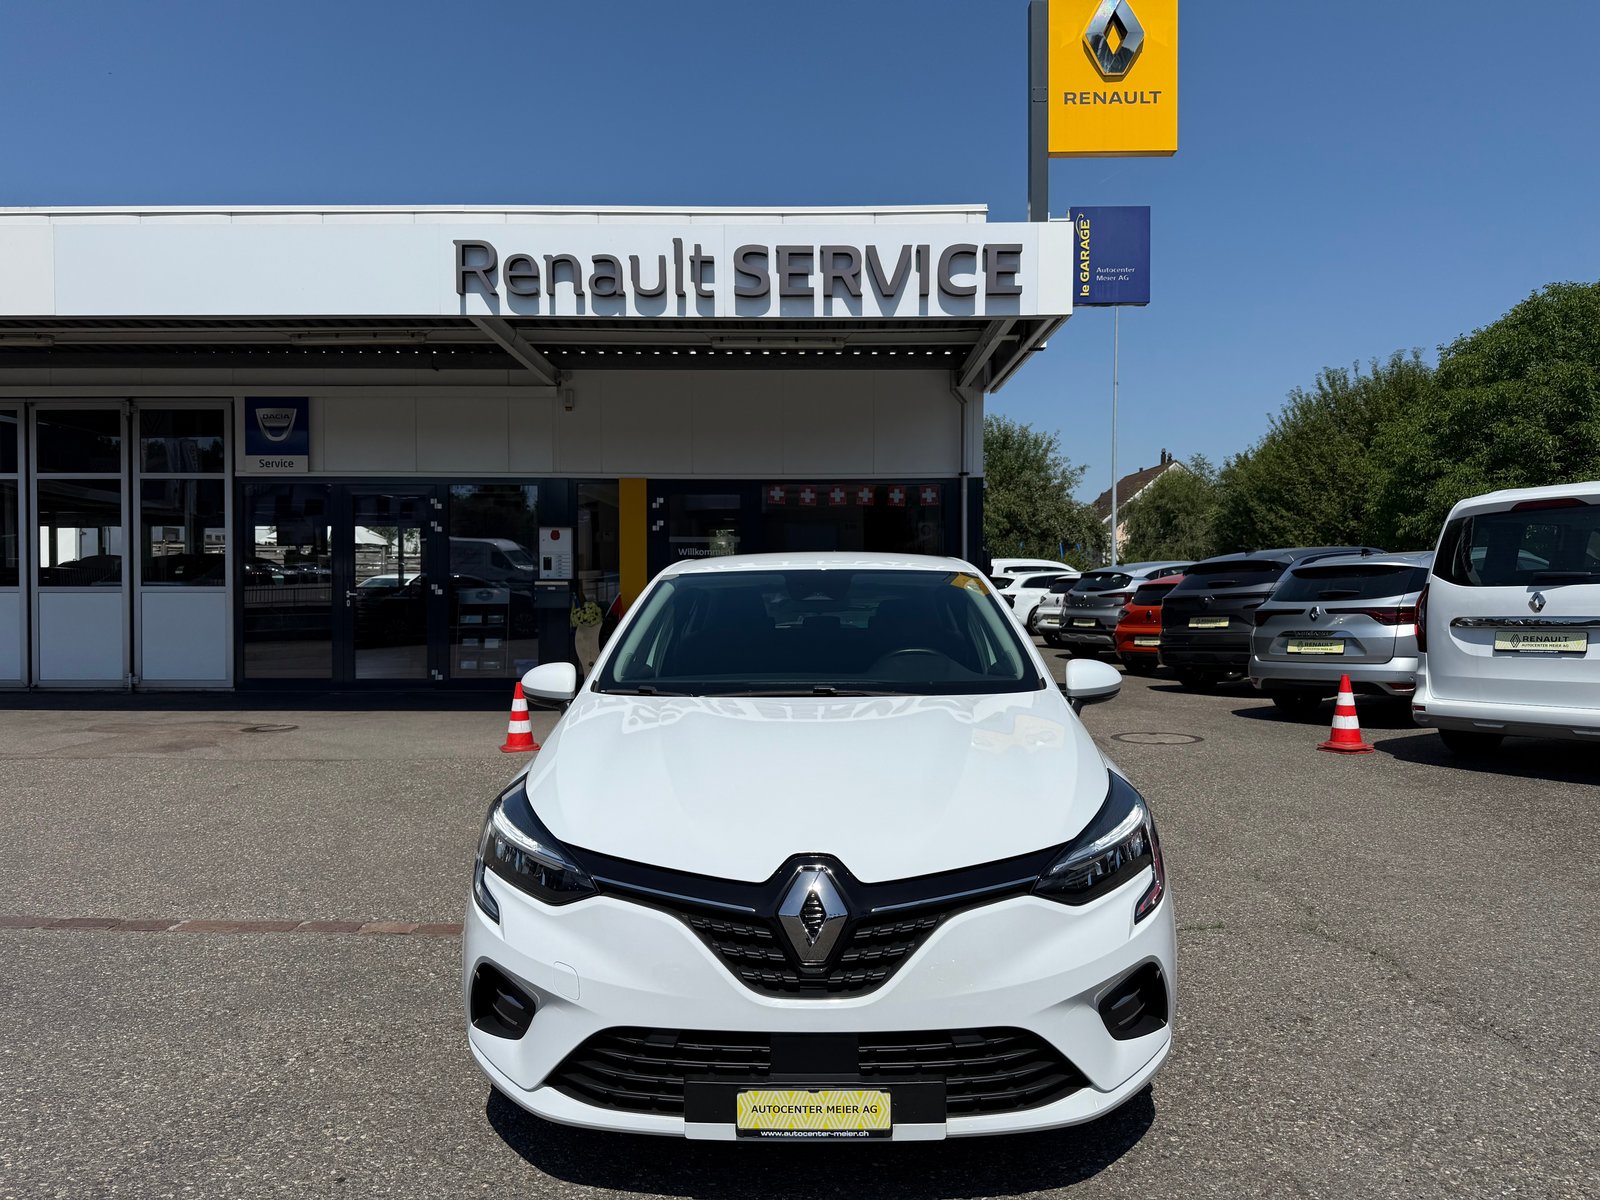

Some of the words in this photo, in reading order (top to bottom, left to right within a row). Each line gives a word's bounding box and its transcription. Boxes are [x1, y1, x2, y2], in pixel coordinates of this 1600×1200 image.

[1064, 91, 1162, 105] RENAULT
[1079, 219, 1090, 283] GARAGE
[452, 237, 715, 297] Renault
[733, 243, 1023, 297] SERVICE
[1080, 284, 1090, 297] le
[258, 458, 294, 468] Service
[1522, 635, 1570, 643] RENAULT
[751, 1105, 823, 1114] AUTOCENTER
[826, 1105, 859, 1114] MEIER
[863, 1105, 878, 1114] AG
